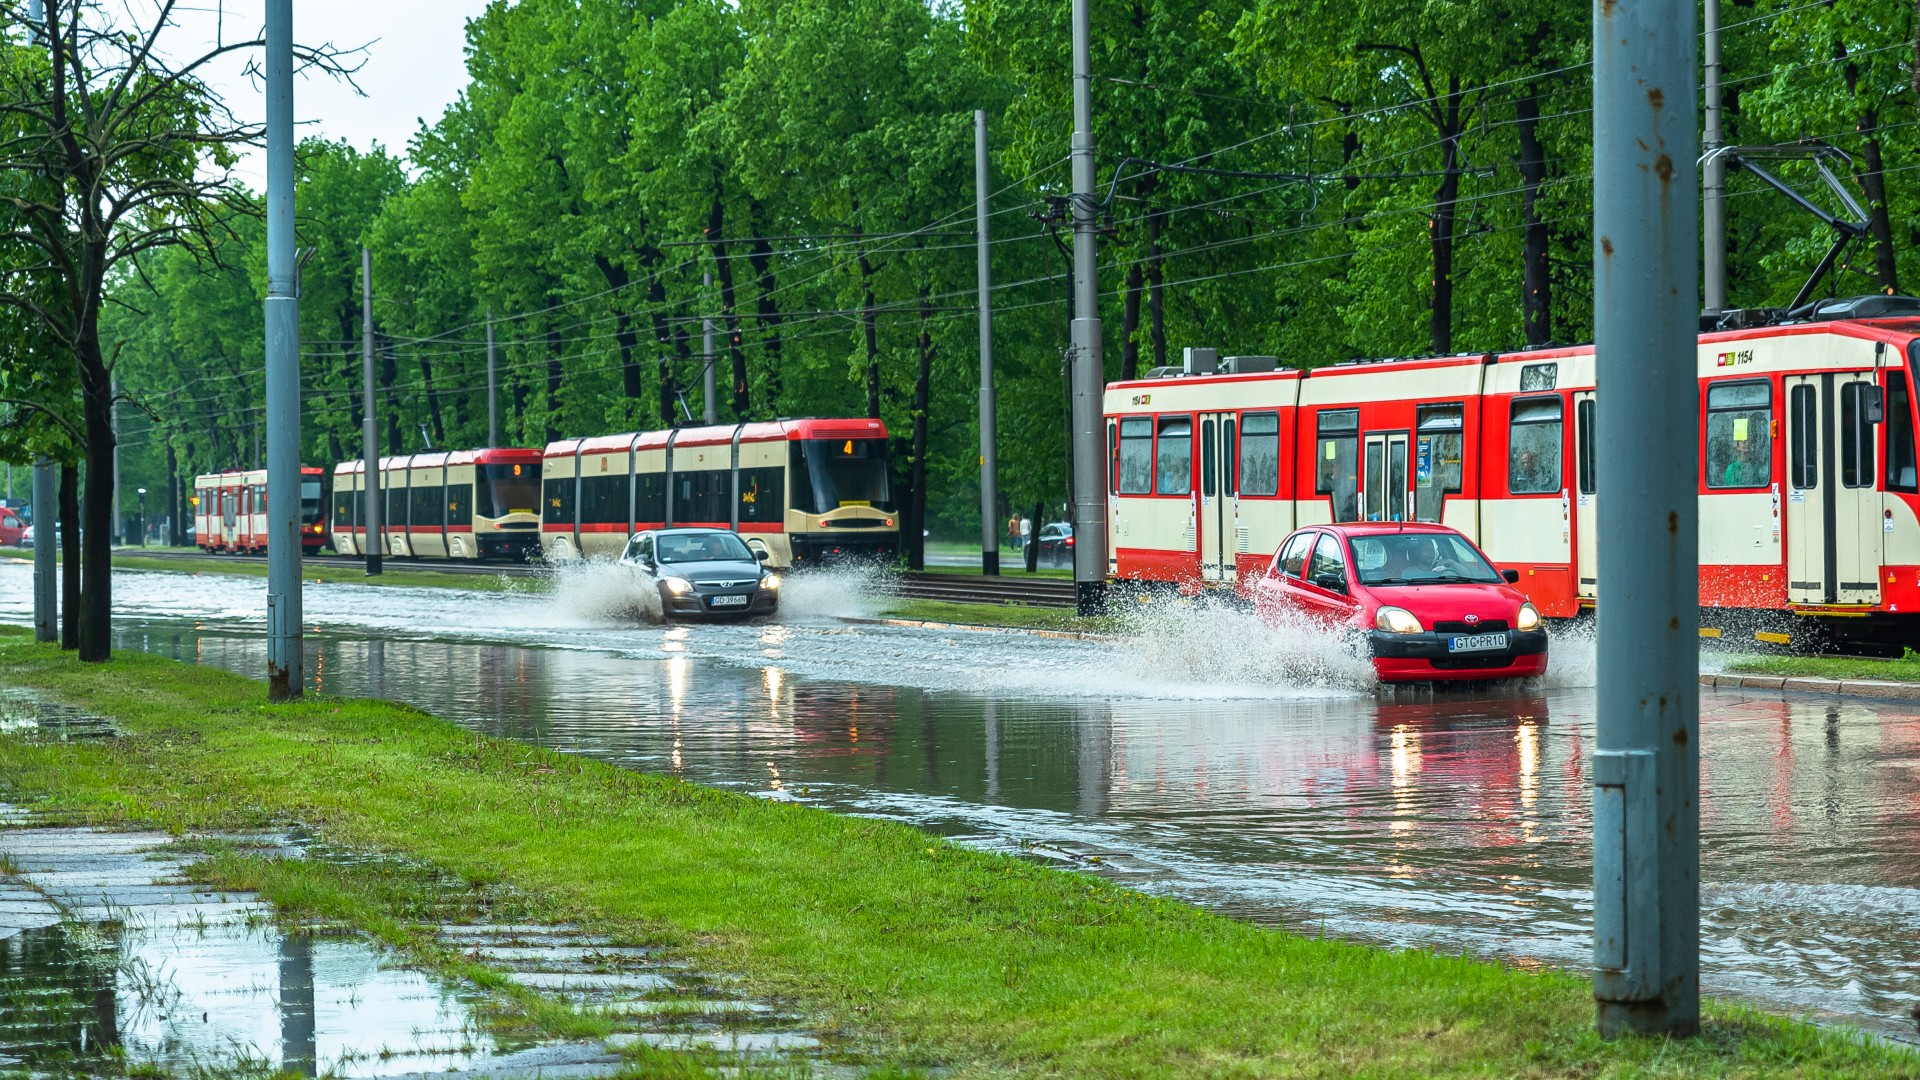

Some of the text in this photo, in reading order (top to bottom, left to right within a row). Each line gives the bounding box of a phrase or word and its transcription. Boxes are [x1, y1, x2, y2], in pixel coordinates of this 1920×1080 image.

[1738, 350, 1753, 365] 1154
[844, 440, 852, 454] 4
[514, 465, 521, 475] 9
[1456, 635, 1504, 648] GTC PR10
